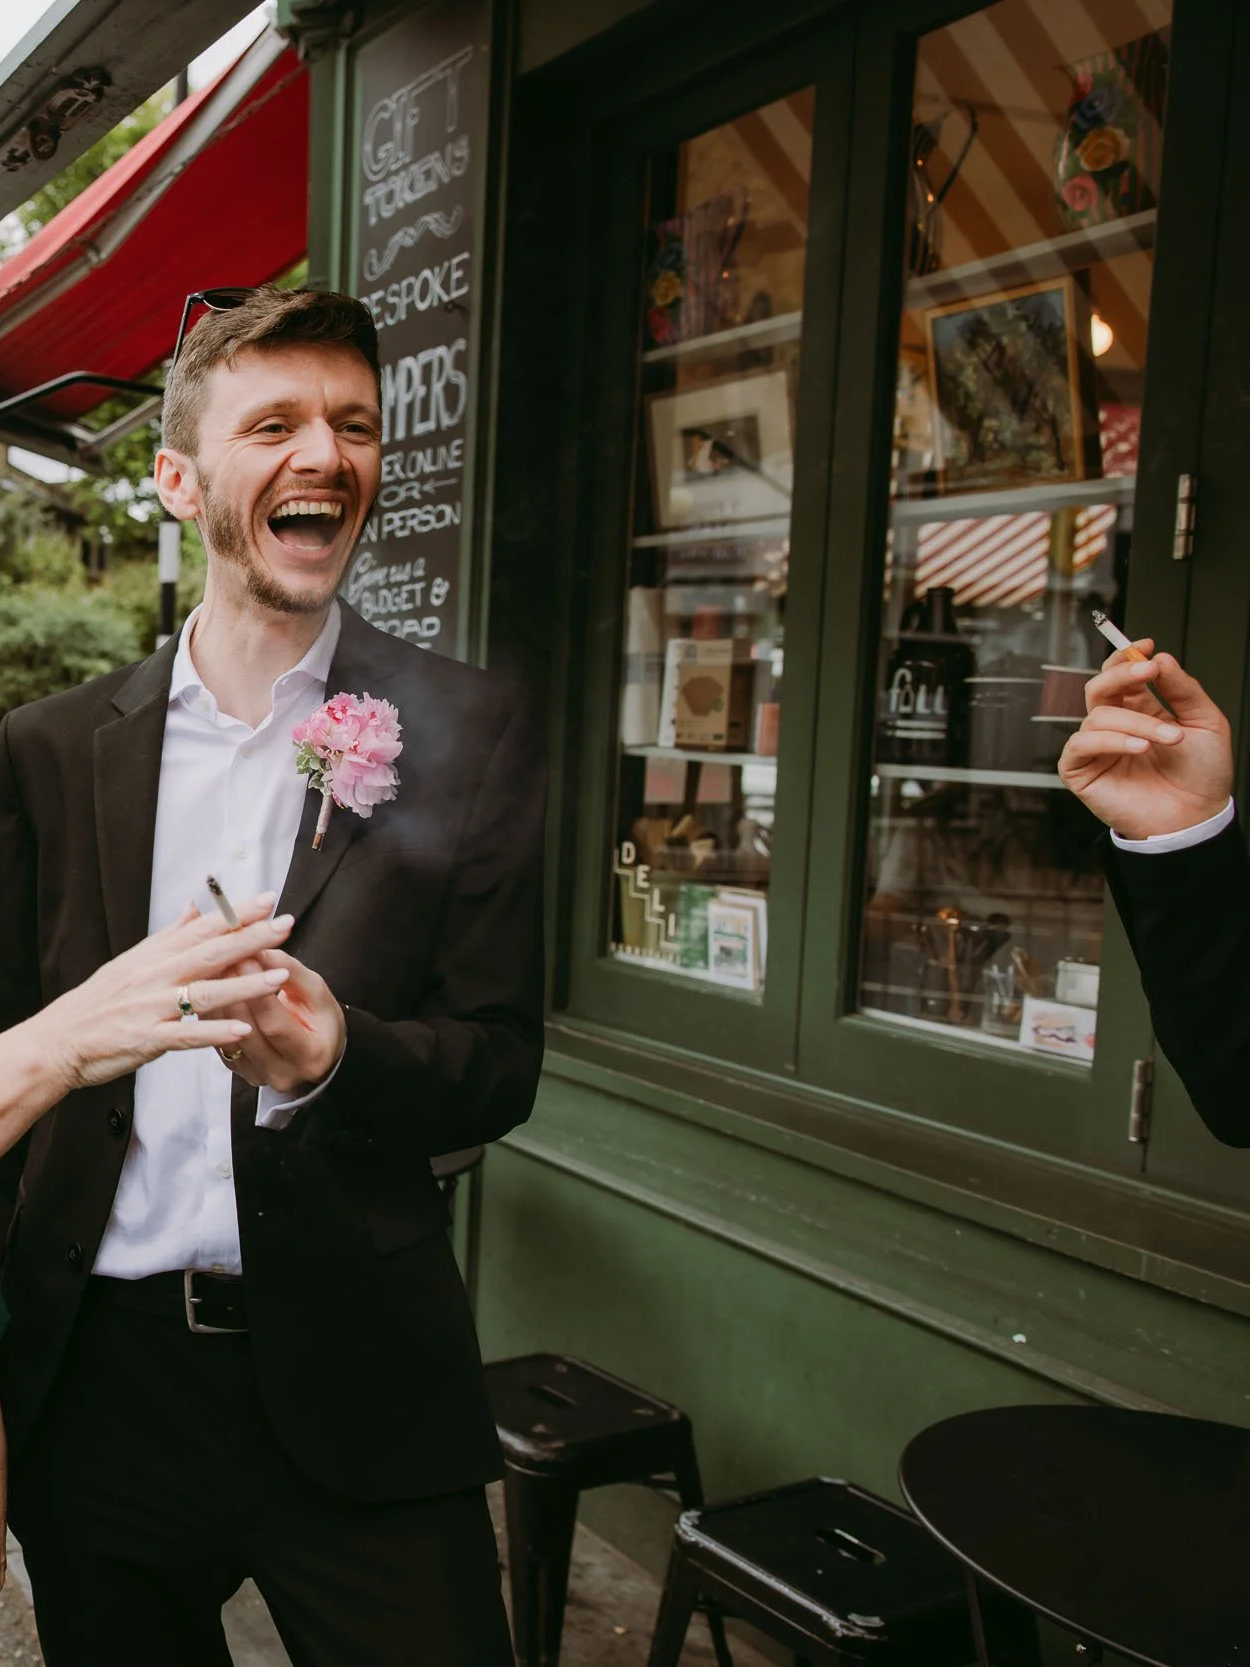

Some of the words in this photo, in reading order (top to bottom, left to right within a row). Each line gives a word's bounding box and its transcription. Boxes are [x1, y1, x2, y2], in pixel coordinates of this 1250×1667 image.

[363, 45, 473, 182] GIFT
[363, 135, 470, 227] TOKENS
[381, 337, 468, 445] MPERS
[405, 438, 465, 479] ONLINE
[359, 516, 379, 545] N
[382, 501, 462, 540] PERSON
[377, 480, 422, 508] OR
[360, 580, 427, 621] BUDGET
[621, 840, 677, 938] DELI
